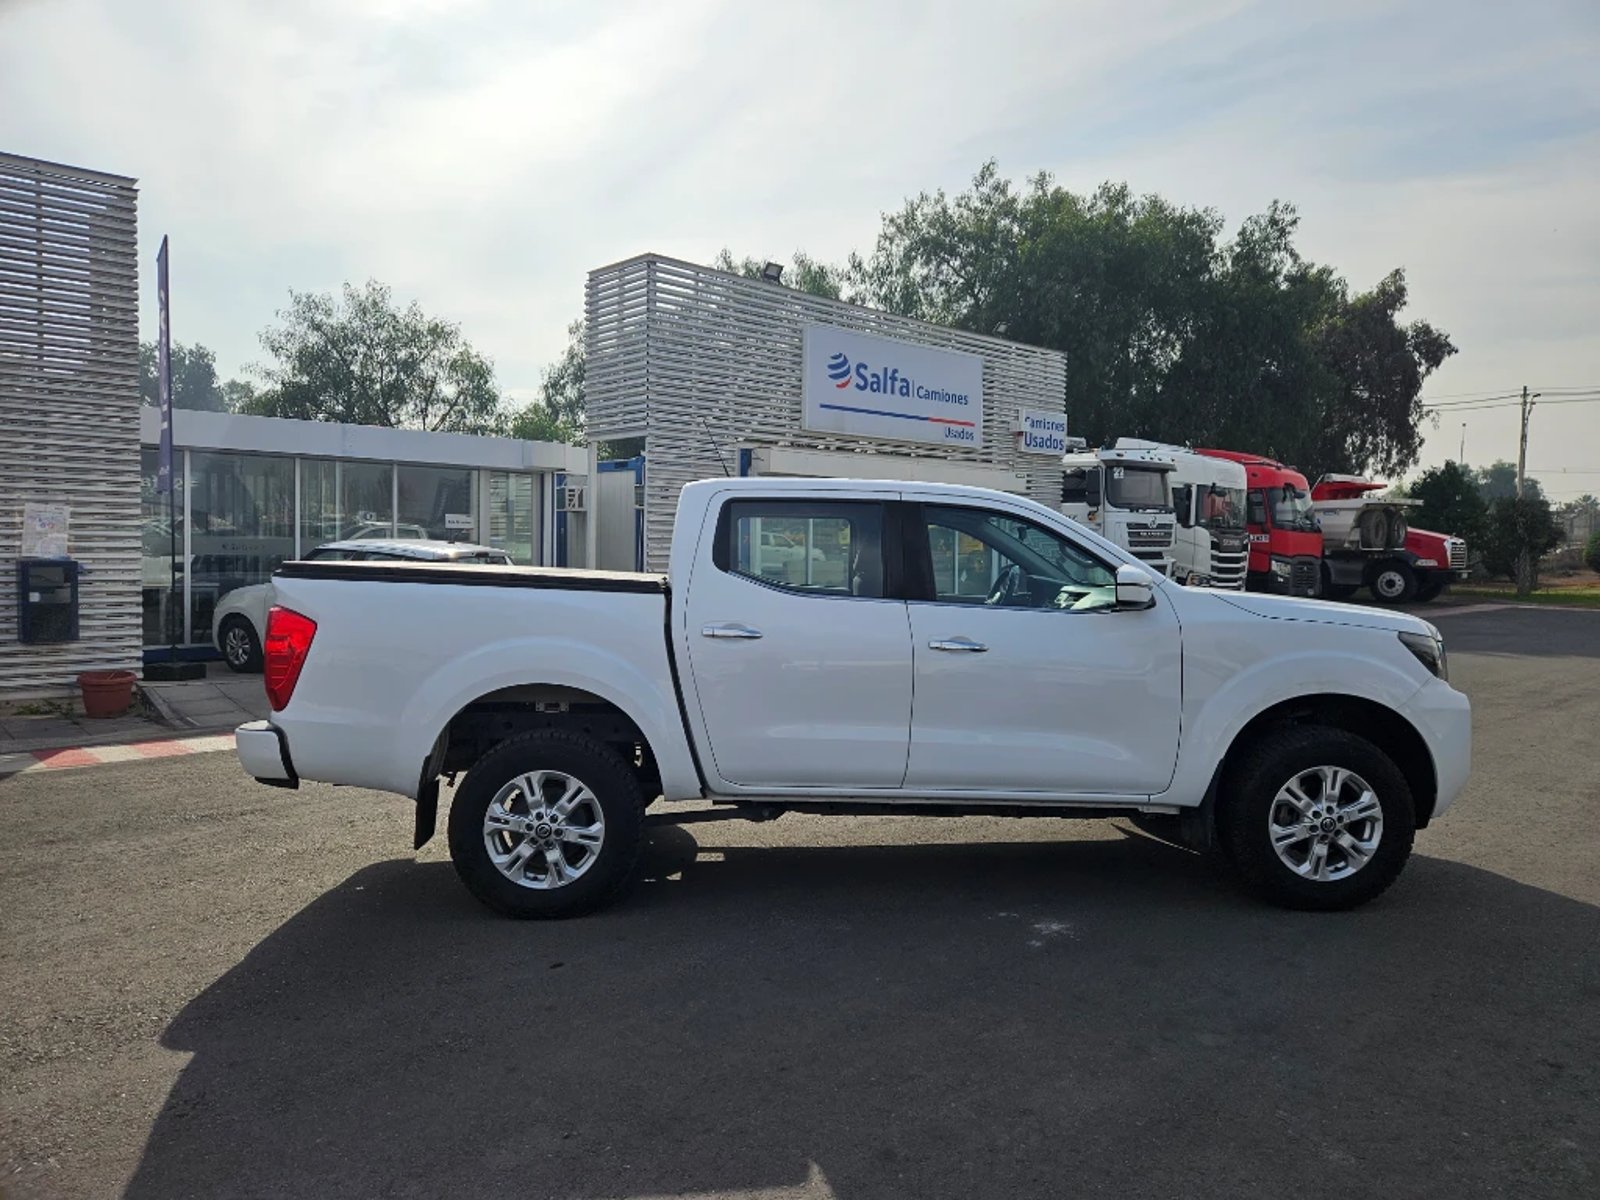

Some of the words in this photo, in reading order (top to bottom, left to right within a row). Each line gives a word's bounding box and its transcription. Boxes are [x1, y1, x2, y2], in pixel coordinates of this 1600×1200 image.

[855, 362, 910, 398] Salfa
[916, 386, 968, 406] Camiones
[944, 427, 974, 441] Usados
[1024, 431, 1065, 451] Usados
